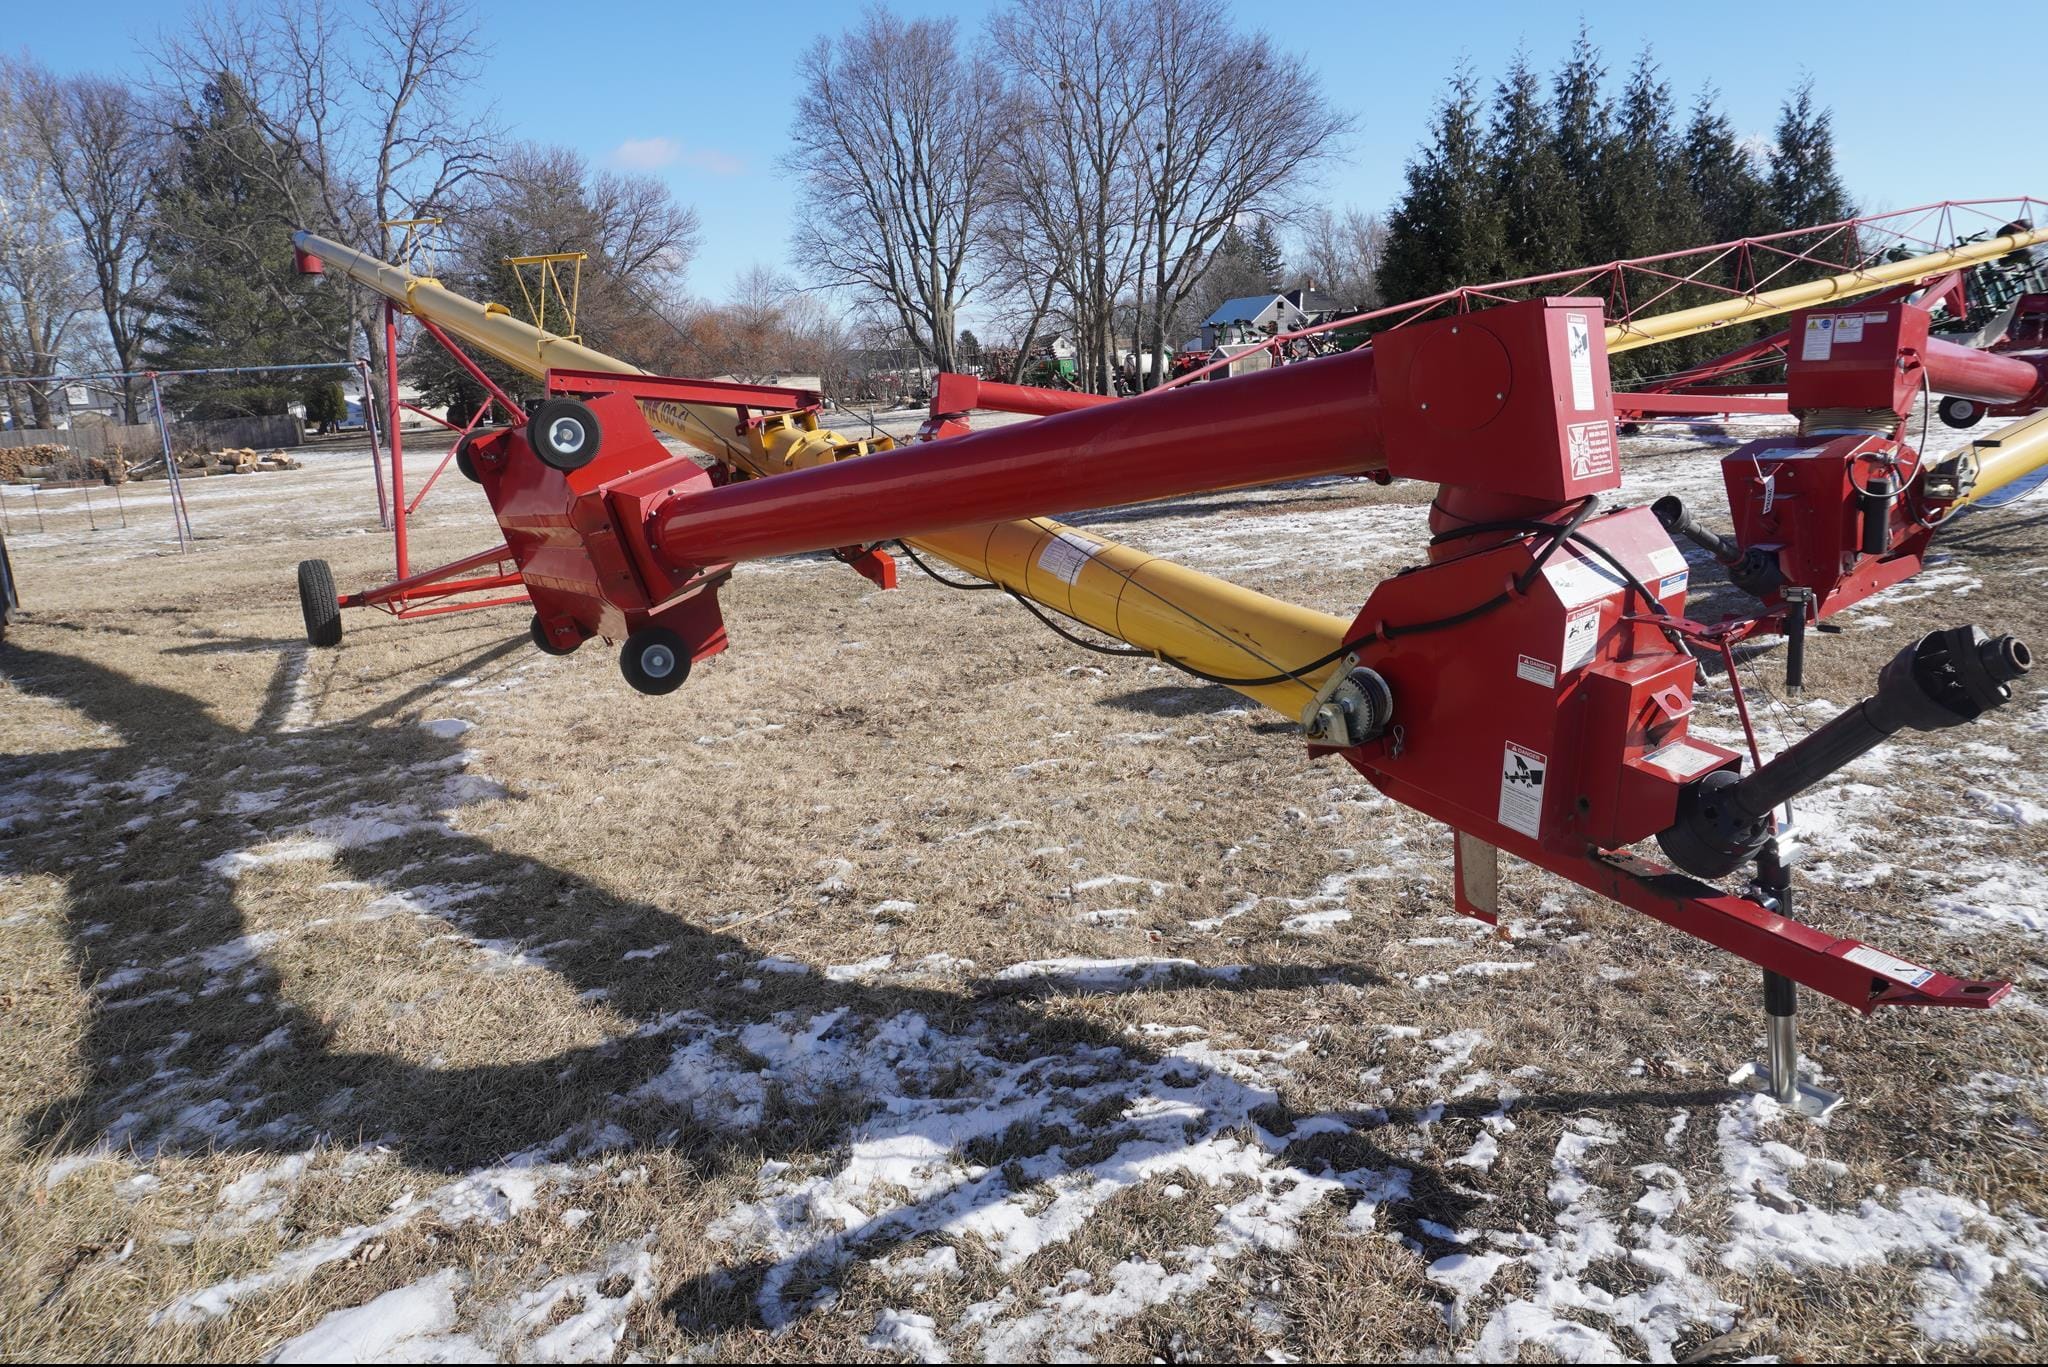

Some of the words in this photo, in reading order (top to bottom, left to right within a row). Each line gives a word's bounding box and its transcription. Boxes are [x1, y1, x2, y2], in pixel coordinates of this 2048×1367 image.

[1576, 606, 1596, 619] DANGER
[1529, 660, 1551, 671] DANGER
[1517, 747, 1541, 761] DANGER
